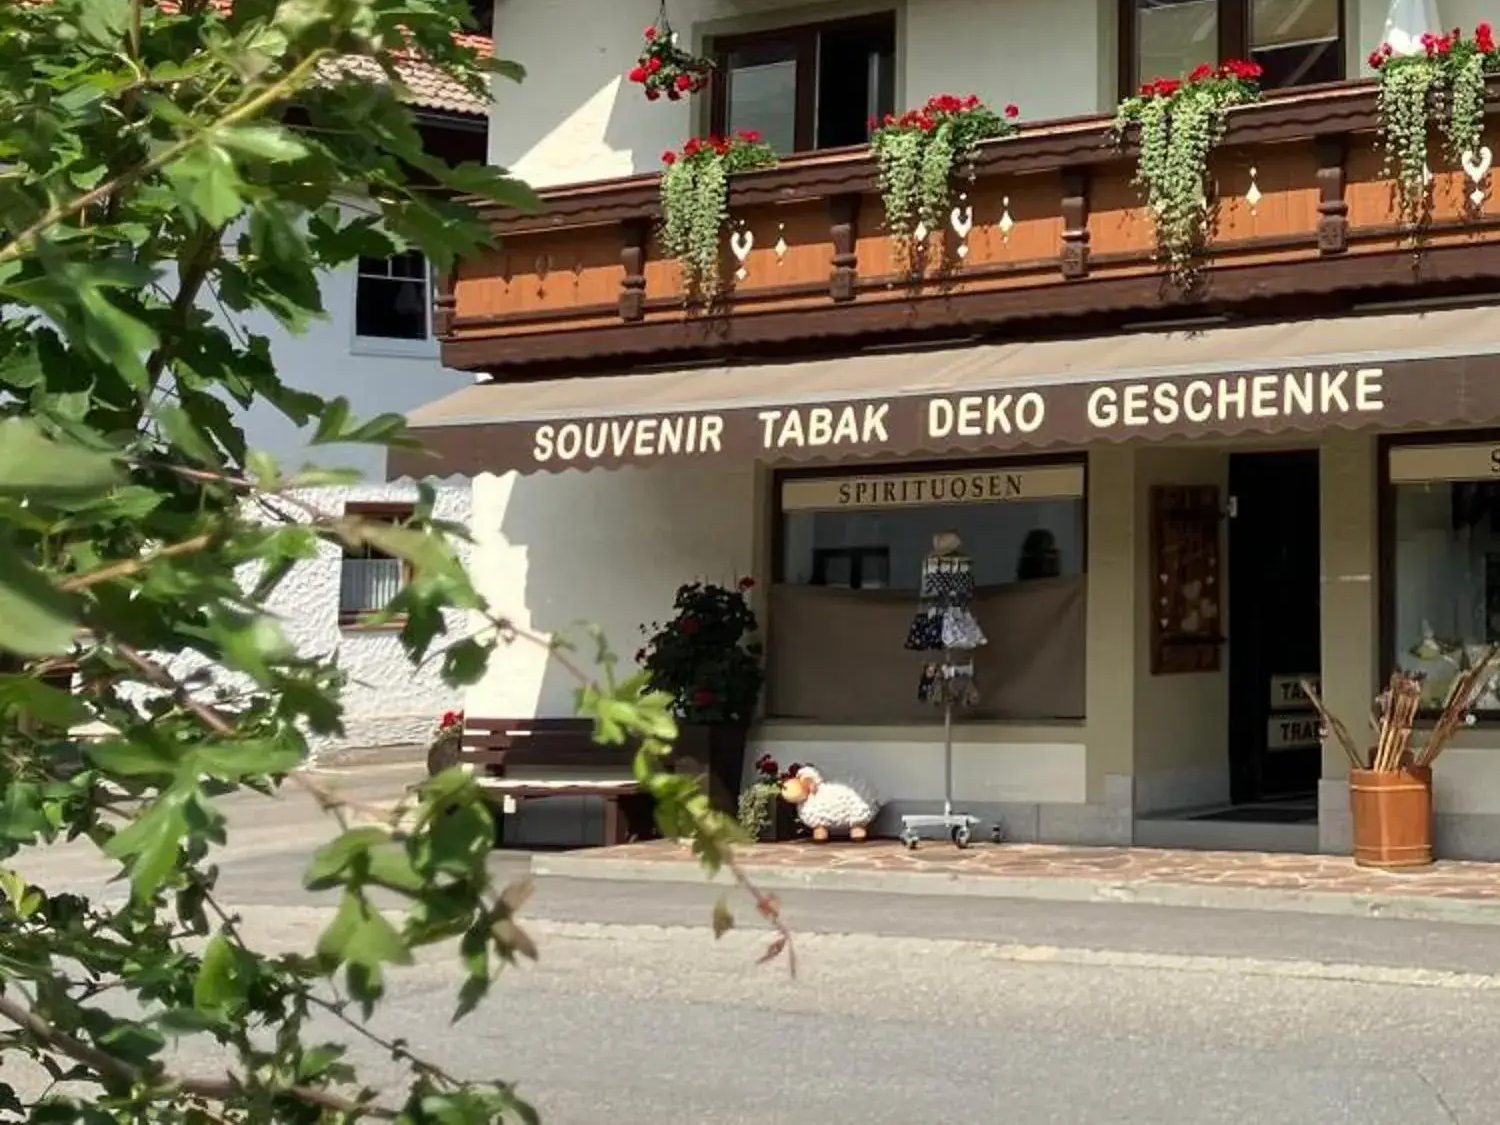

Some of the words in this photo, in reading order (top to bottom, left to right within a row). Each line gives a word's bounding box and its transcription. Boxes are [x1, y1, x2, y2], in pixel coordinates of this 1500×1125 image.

[533, 415, 724, 462] SOUVENIR
[758, 403, 889, 448] TABAK
[928, 392, 1045, 437] DEKO
[1087, 368, 1385, 428] GESCHENKE
[839, 475, 1024, 504] SPIRITUOSEN
